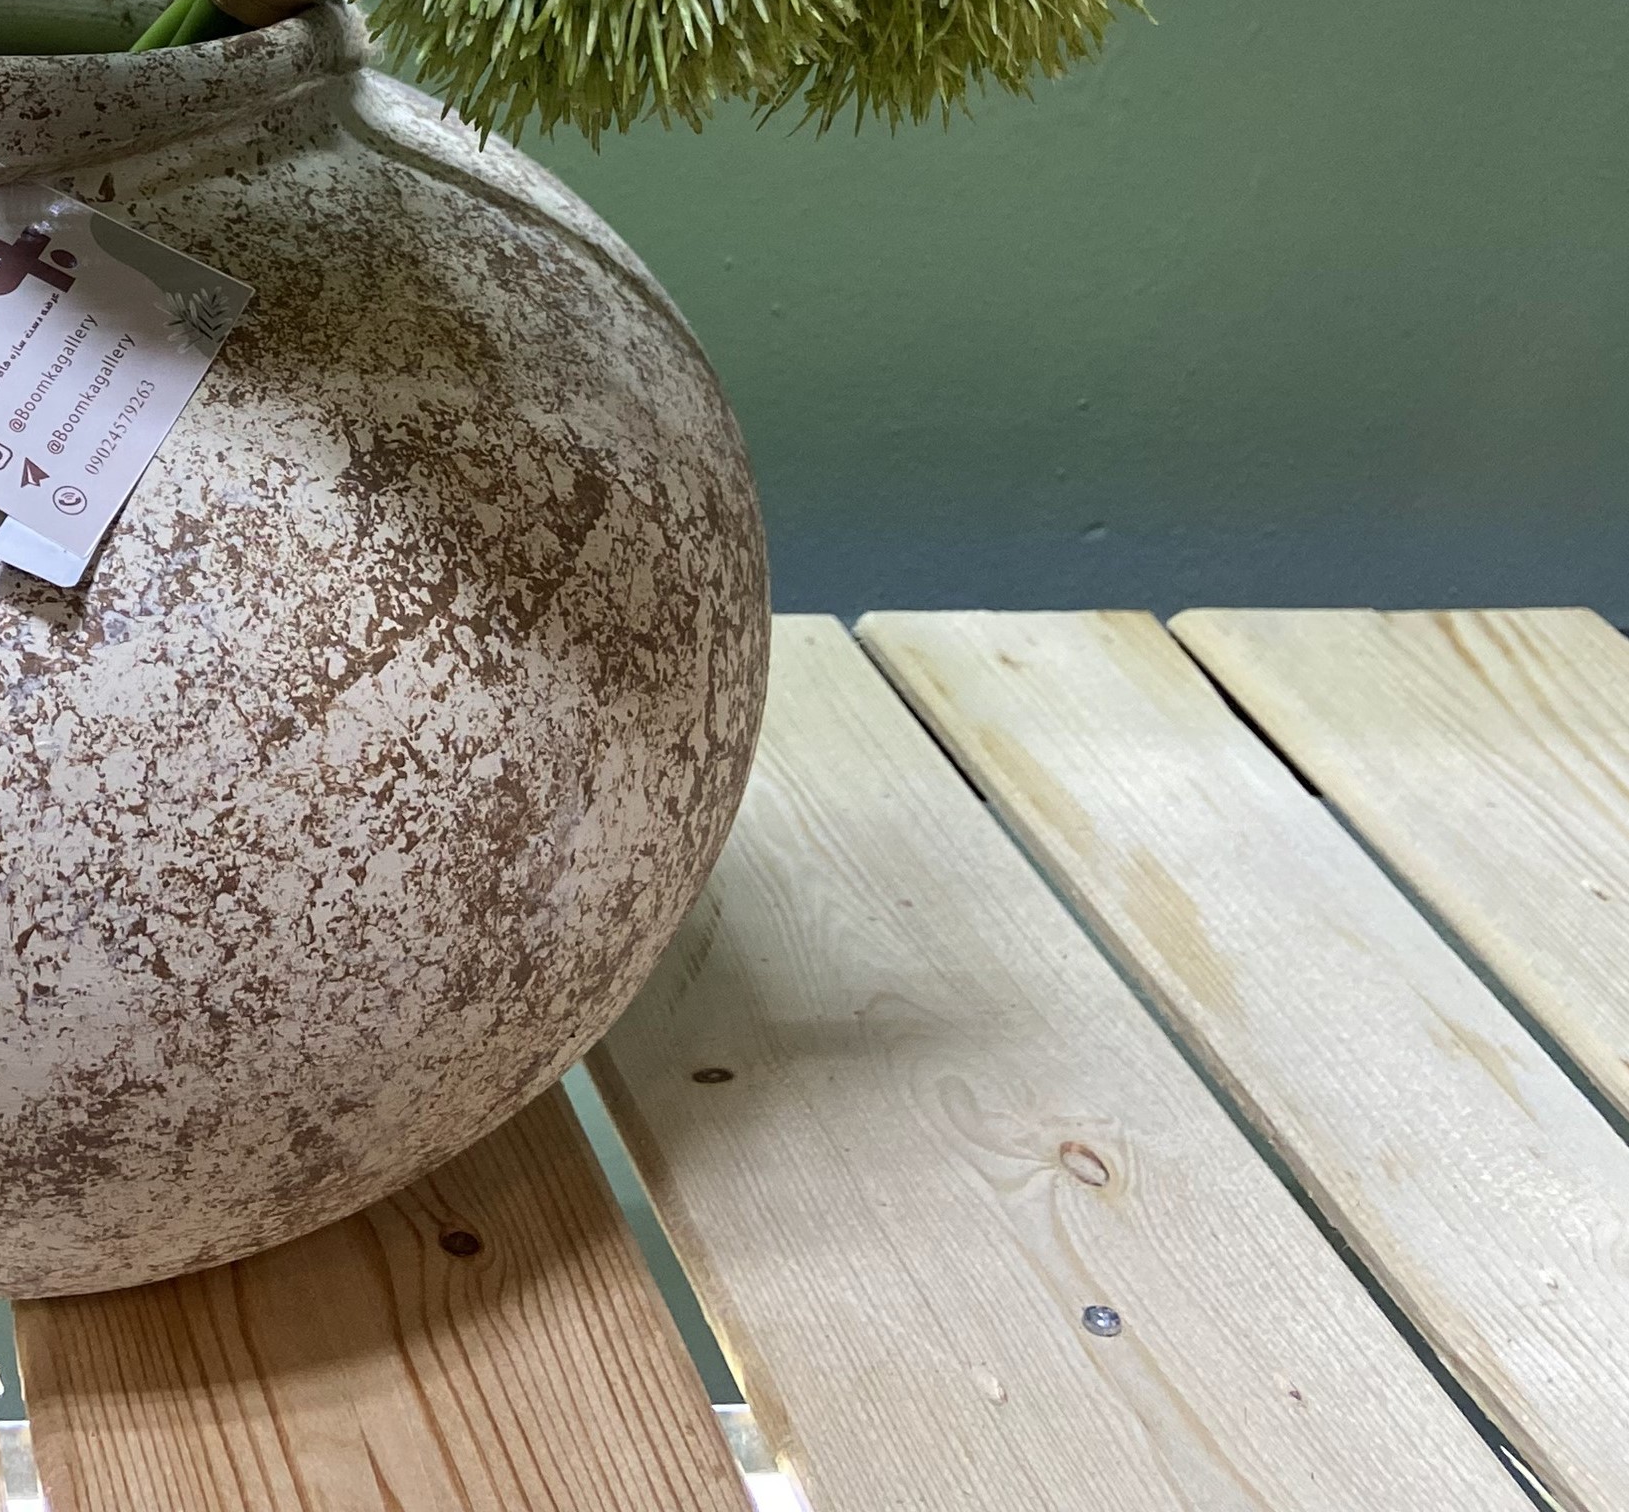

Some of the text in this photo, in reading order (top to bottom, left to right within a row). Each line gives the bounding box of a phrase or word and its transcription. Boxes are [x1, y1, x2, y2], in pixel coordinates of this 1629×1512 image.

[9, 313, 99, 433] @Boomkagallery
[47, 332, 136, 455] @Boomkagallery
[84, 379, 156, 476] 09024579263
